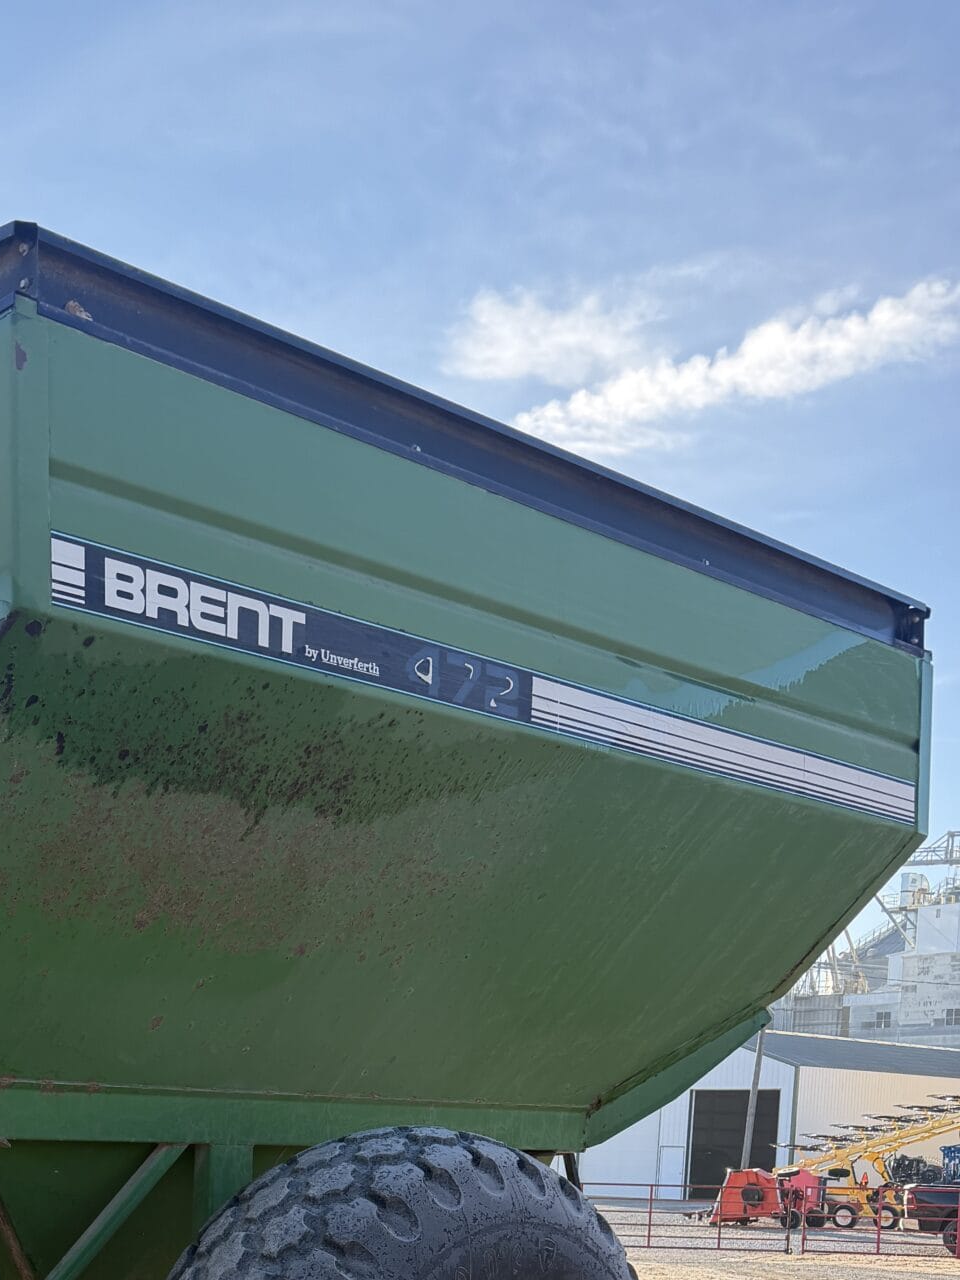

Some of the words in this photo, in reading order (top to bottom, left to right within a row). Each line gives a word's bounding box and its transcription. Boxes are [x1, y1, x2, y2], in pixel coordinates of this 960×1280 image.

[105, 557, 306, 653] BRENT
[305, 645, 320, 661] by
[321, 649, 380, 676] Unverferth
